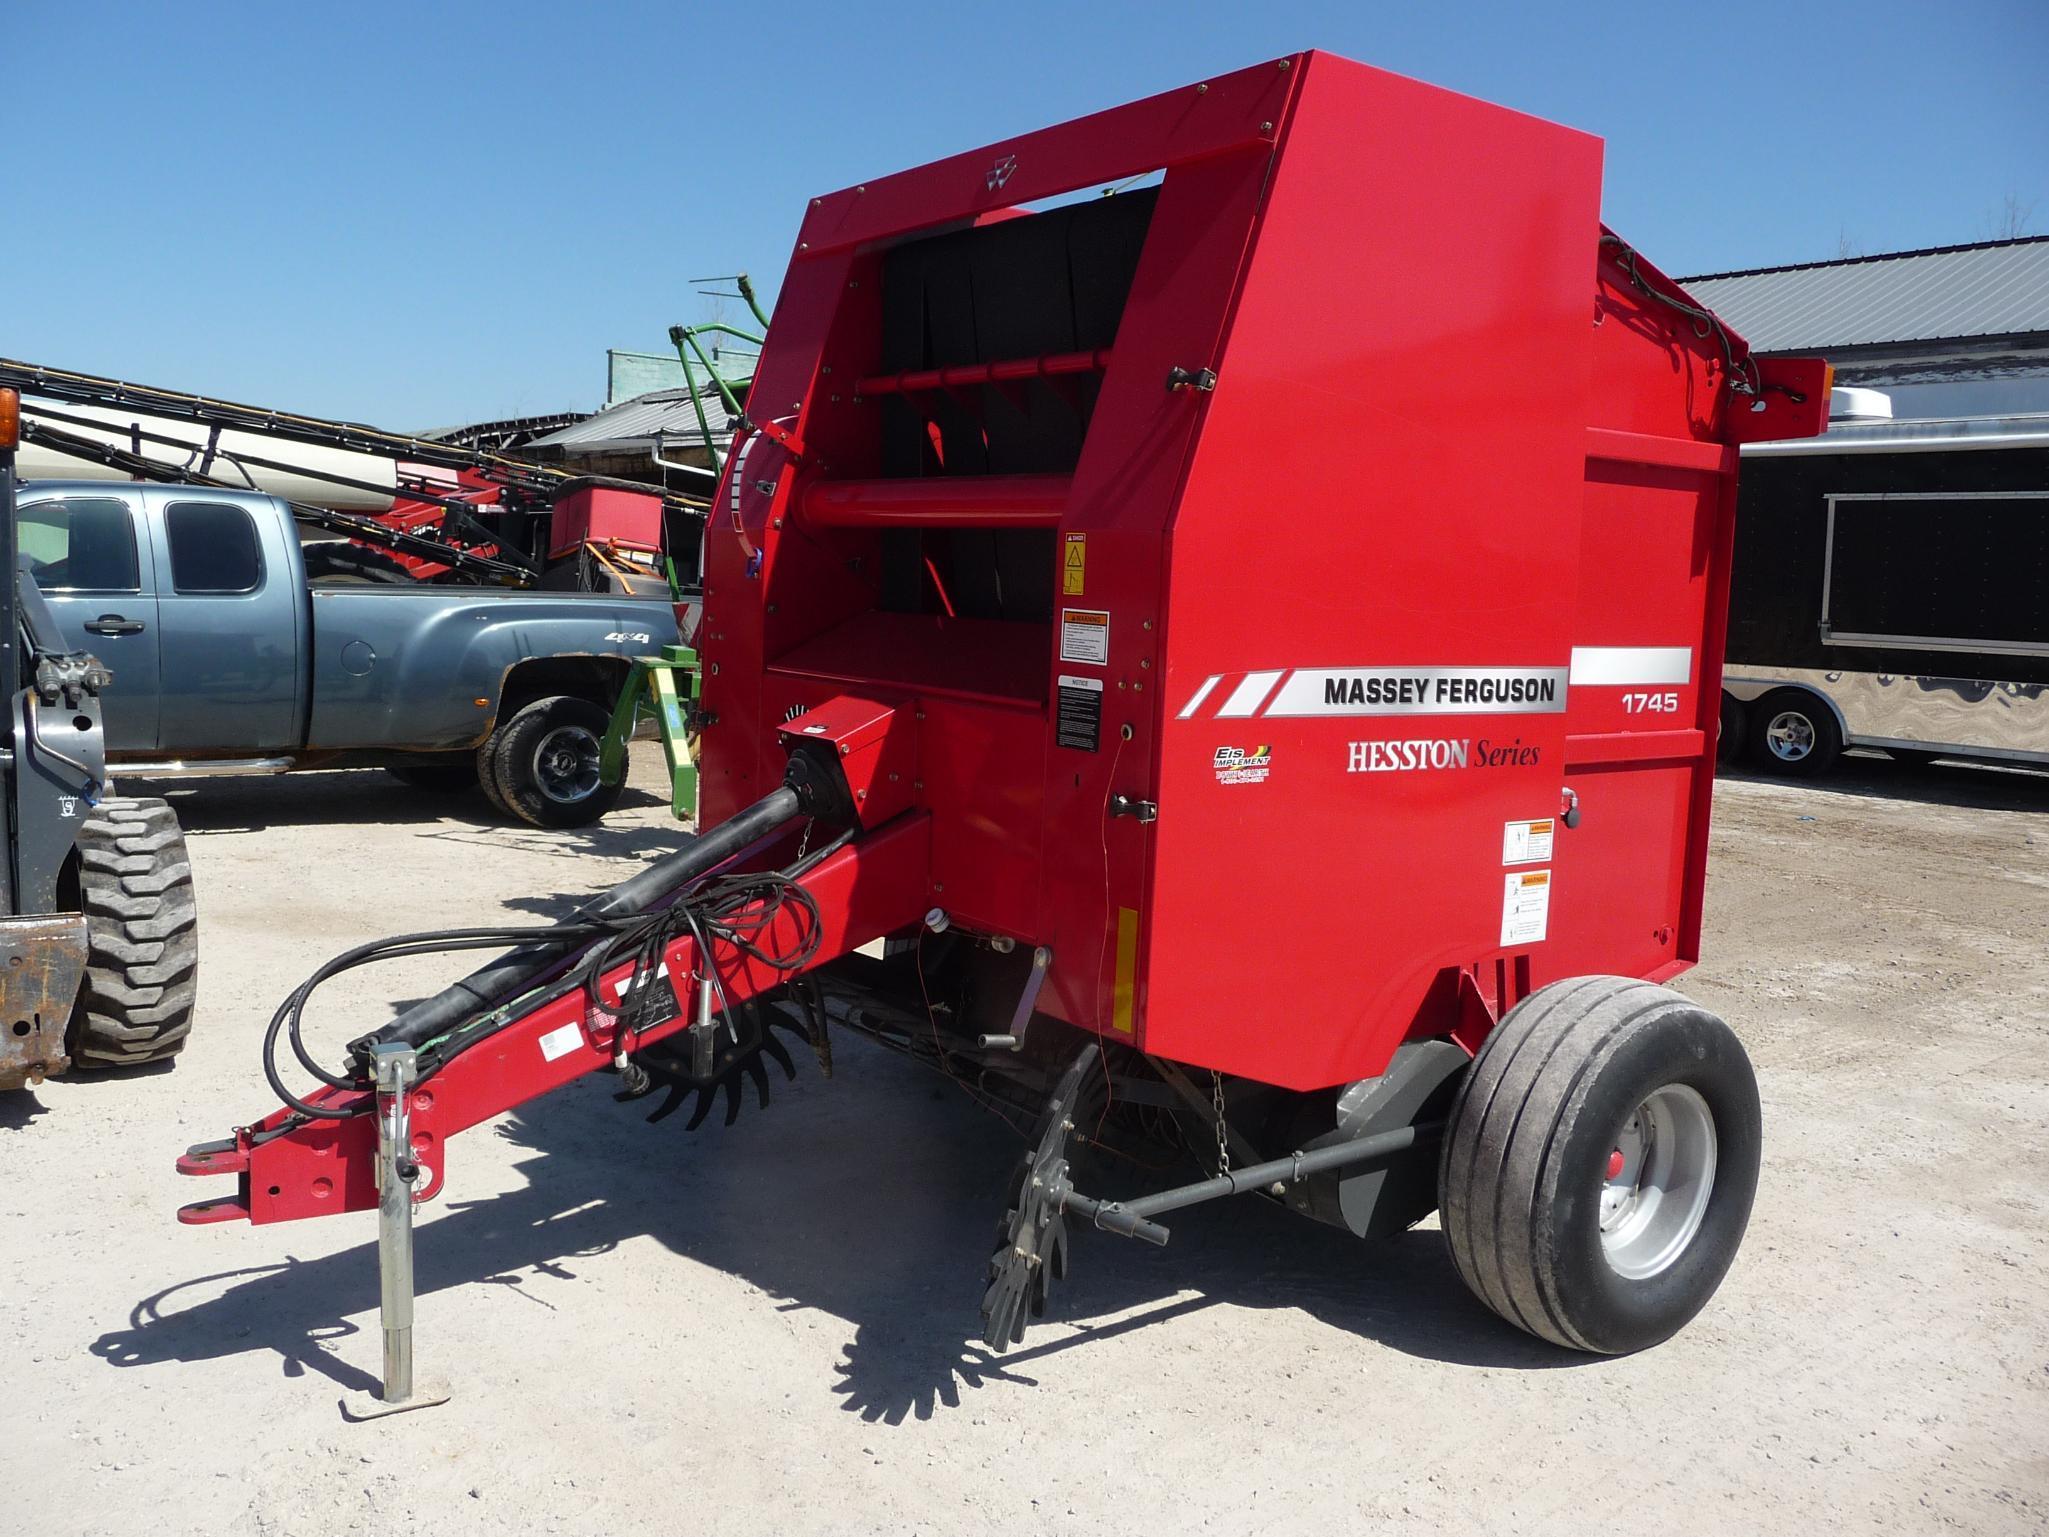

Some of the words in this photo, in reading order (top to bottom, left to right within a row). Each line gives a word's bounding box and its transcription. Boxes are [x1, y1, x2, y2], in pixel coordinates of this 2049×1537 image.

[1324, 678, 1430, 704] MASSEY
[1435, 678, 1556, 703] FERGUSON
[1621, 692, 1679, 714] 1745
[1215, 757, 1269, 767] IMPLEMENT
[1346, 739, 1471, 773] HESSTON
[1473, 738, 1541, 769] Series
